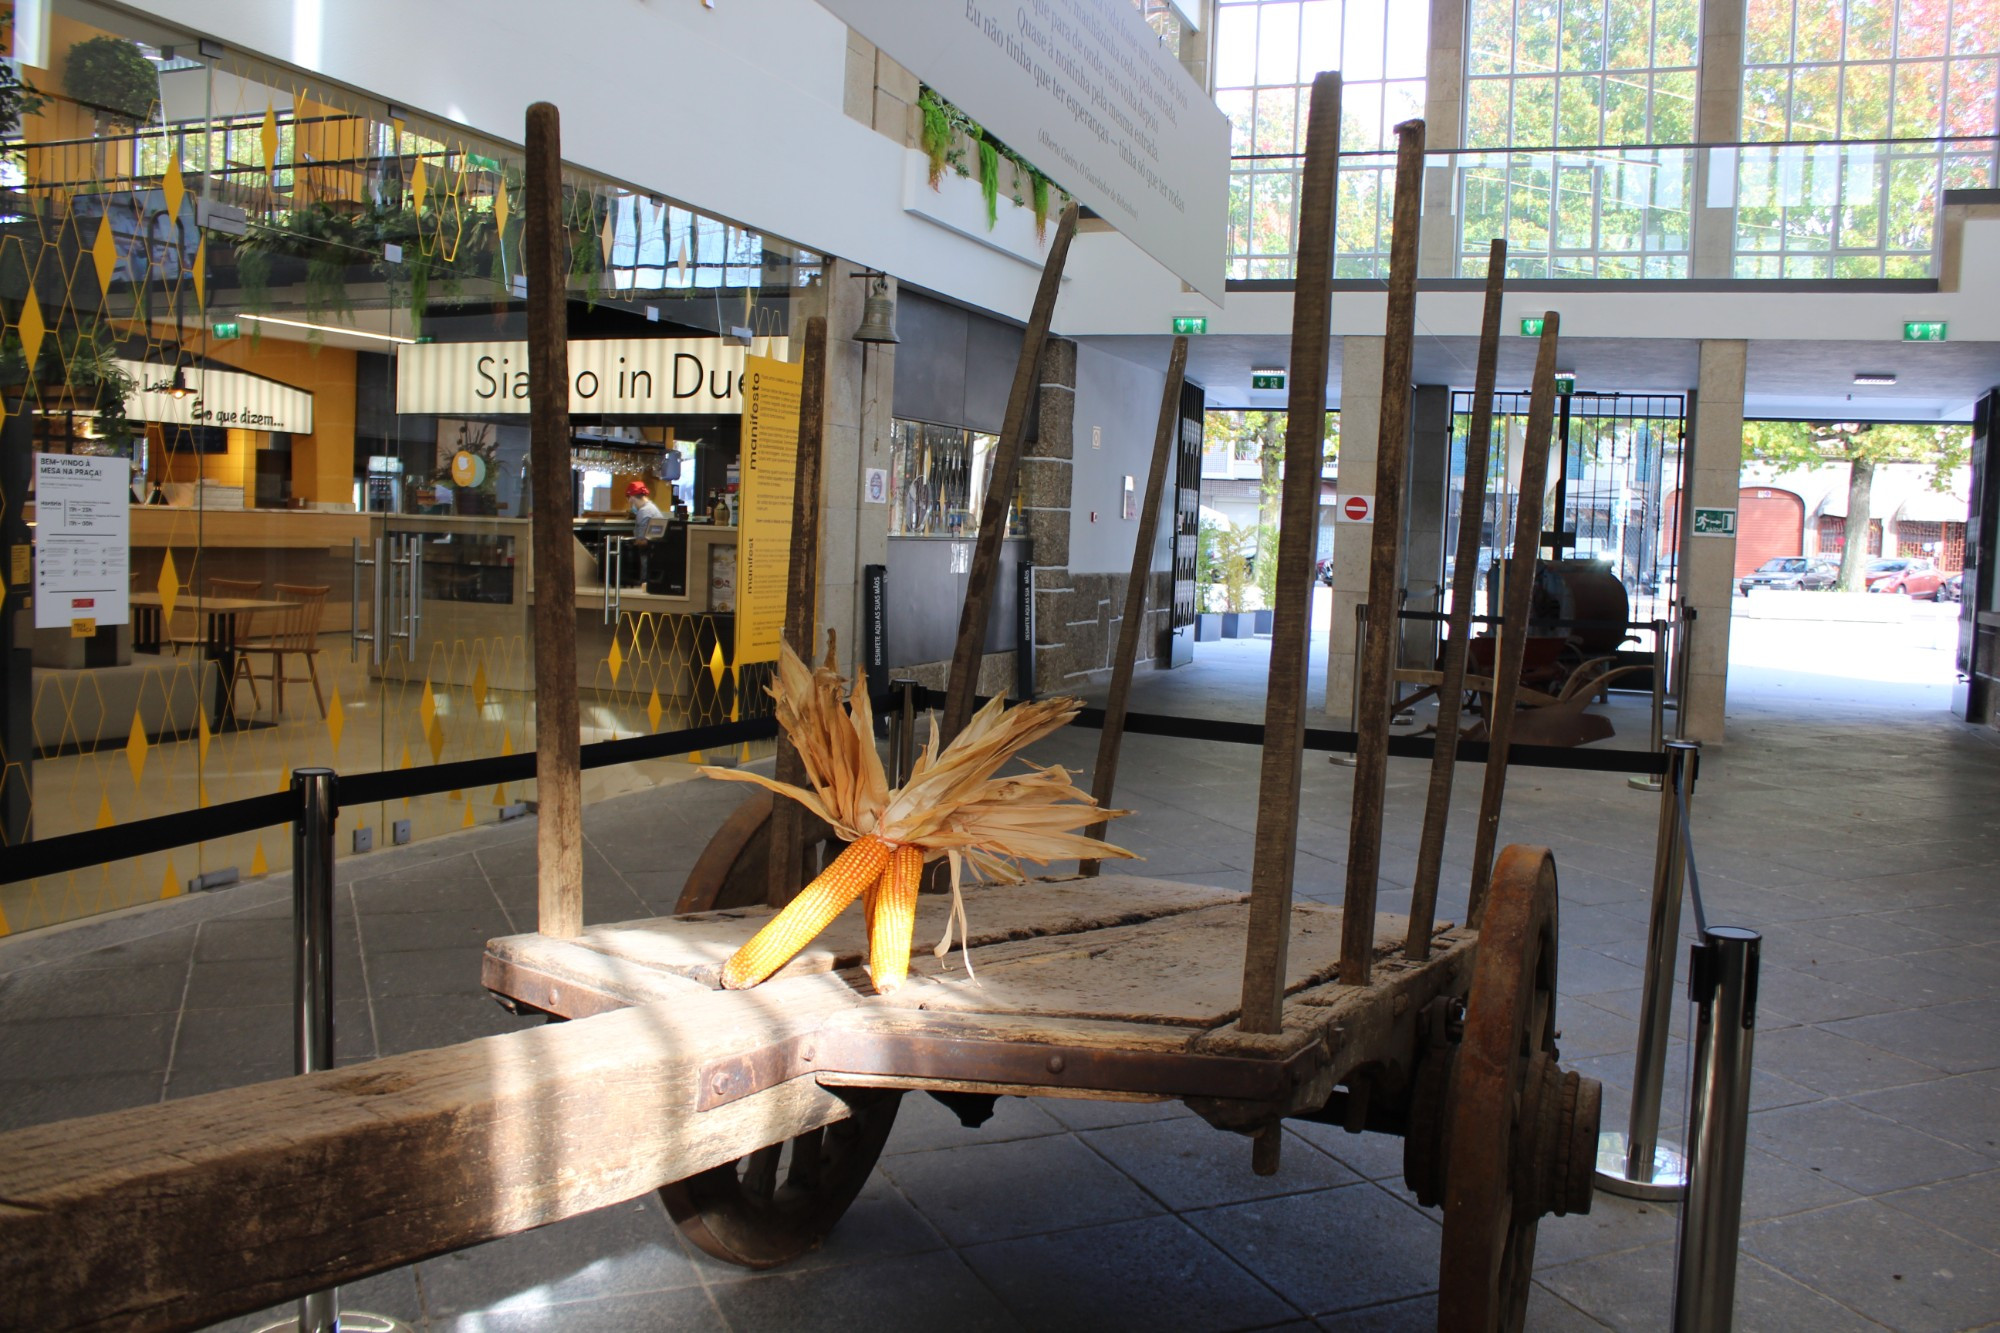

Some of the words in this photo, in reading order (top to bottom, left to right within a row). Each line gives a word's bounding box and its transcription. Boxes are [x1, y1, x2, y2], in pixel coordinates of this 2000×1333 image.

[1074, 1, 1120, 63] manhãzinha
[1017, 6, 1047, 52] Quase
[1055, 49, 1090, 95] noitinha
[1091, 85, 1107, 114] pela
[1108, 101, 1134, 138] mesma
[1051, 11, 1071, 43] para
[1072, 27, 1083, 55] de
[1084, 45, 1103, 76] onde
[1104, 65, 1120, 93] veio
[1120, 82, 1137, 113] volta
[1138, 97, 1159, 134] depois
[1139, 43, 1150, 68] um
[1151, 57, 1167, 87] carro
[965, 0, 981, 28] Eu
[983, 16, 1004, 48] não
[1006, 33, 1032, 75] tinha
[1033, 63, 1051, 92] que
[1052, 76, 1066, 104] ter
[1066, 94, 1109, 144] esperanças
[1118, 139, 1137, 171] tinha
[1137, 158, 1146, 179] só
[1146, 168, 1159, 190] que
[1159, 178, 1168, 198] ter
[1168, 189, 1186, 215] rodas
[475, 355, 599, 400] Siao
[618, 356, 652, 400] in
[216, 409, 237, 427] que
[240, 407, 285, 428] dizem...
[750, 372, 760, 470] manifesto
[41, 458, 84, 467] BEM-VINDO
[41, 467, 61, 475] MESA
[75, 468, 102, 479] PRAÇA!
[875, 611, 881, 620] AS
